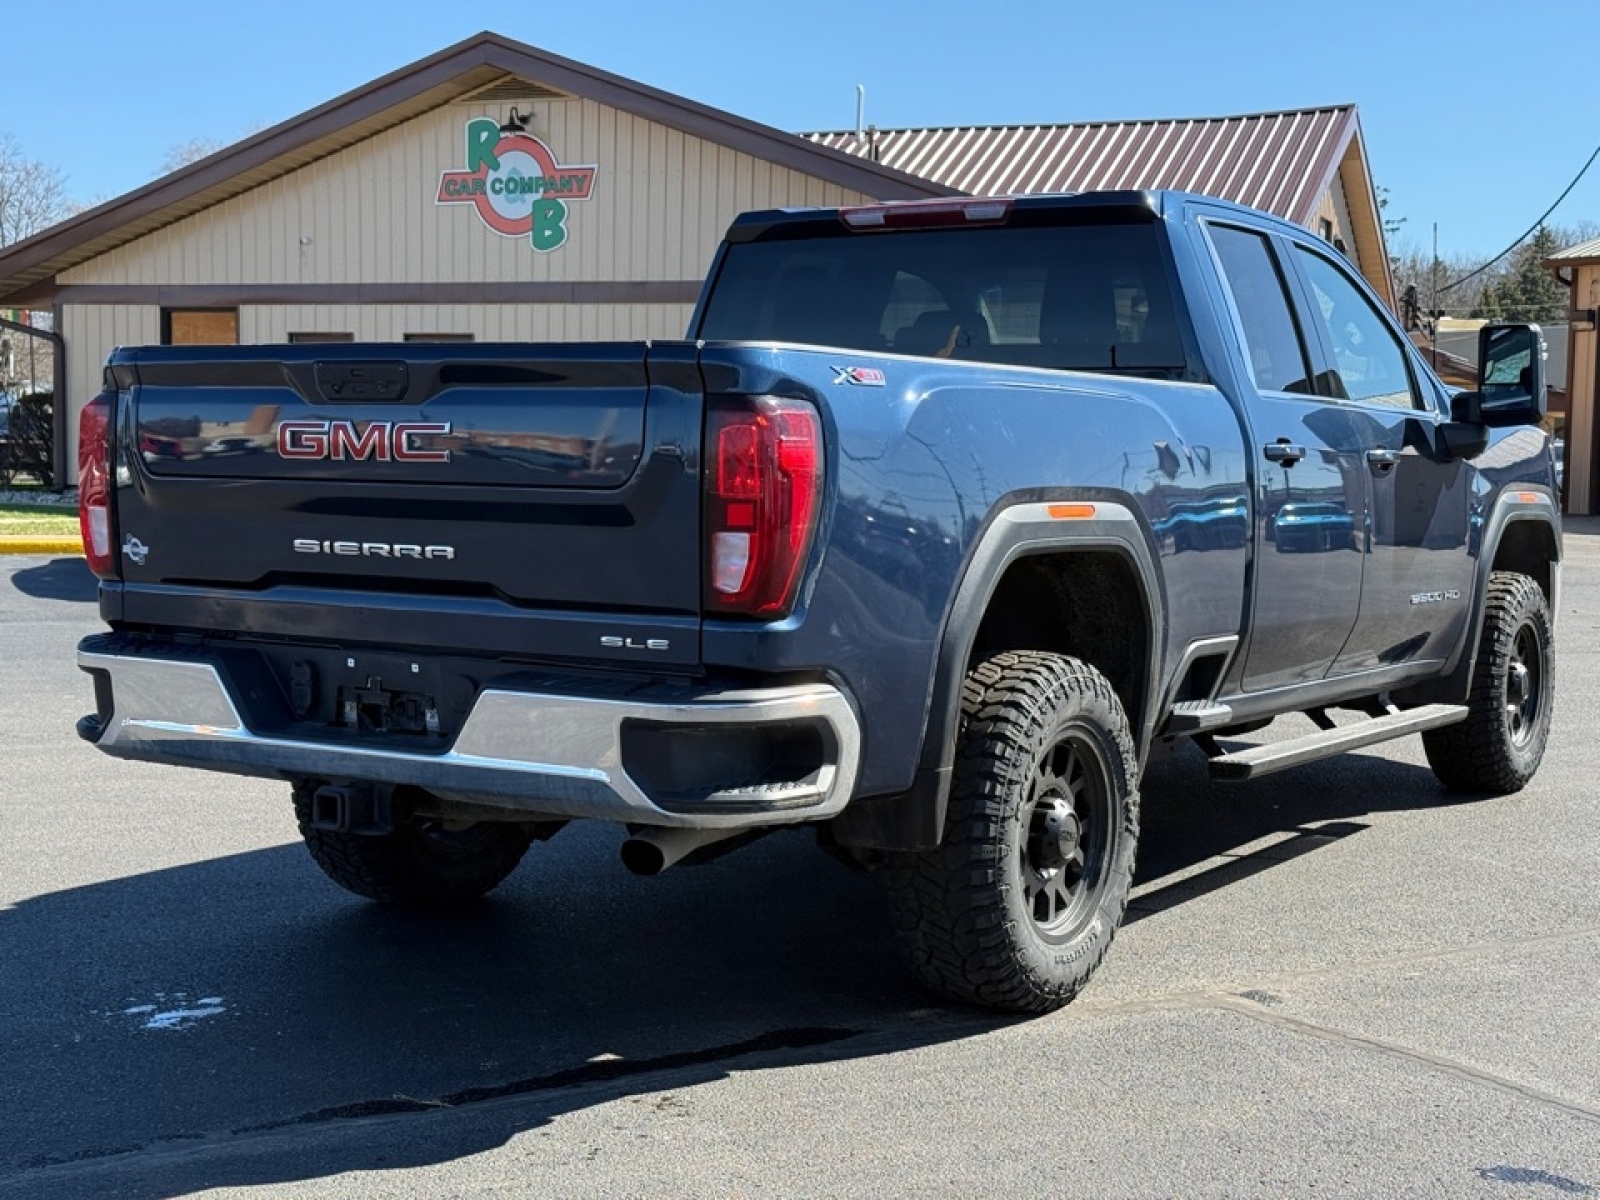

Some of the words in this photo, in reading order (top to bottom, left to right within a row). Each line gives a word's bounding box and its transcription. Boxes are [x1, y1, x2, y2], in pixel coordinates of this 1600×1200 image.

[467, 118, 501, 173] R
[444, 177, 487, 196] CAR
[490, 174, 588, 196] COMPANY
[531, 198, 567, 251] B
[277, 420, 451, 463] GMC
[292, 538, 456, 560] SIERRA
[600, 636, 670, 651] SLE
